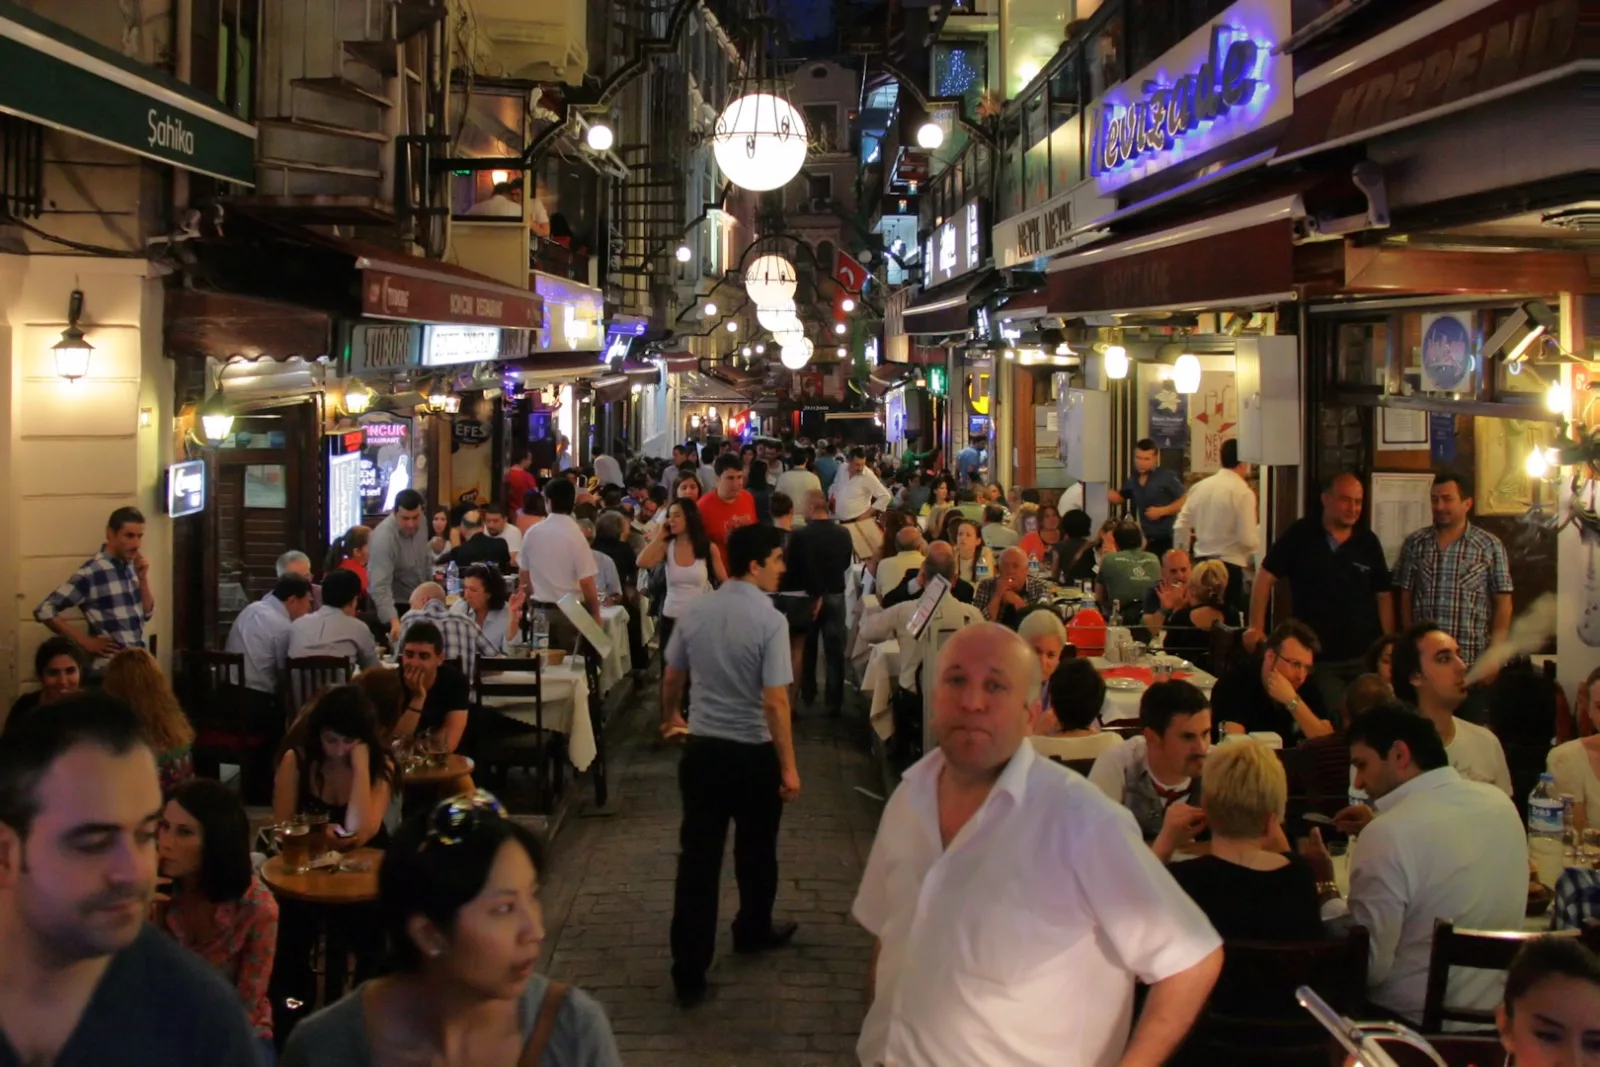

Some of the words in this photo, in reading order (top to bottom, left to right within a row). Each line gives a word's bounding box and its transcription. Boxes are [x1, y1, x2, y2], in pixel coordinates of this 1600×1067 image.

[147, 108, 194, 155] Şahika
[365, 326, 410, 368] TUBORG
[455, 423, 488, 438] EFES
[1205, 432, 1223, 447] NEY
